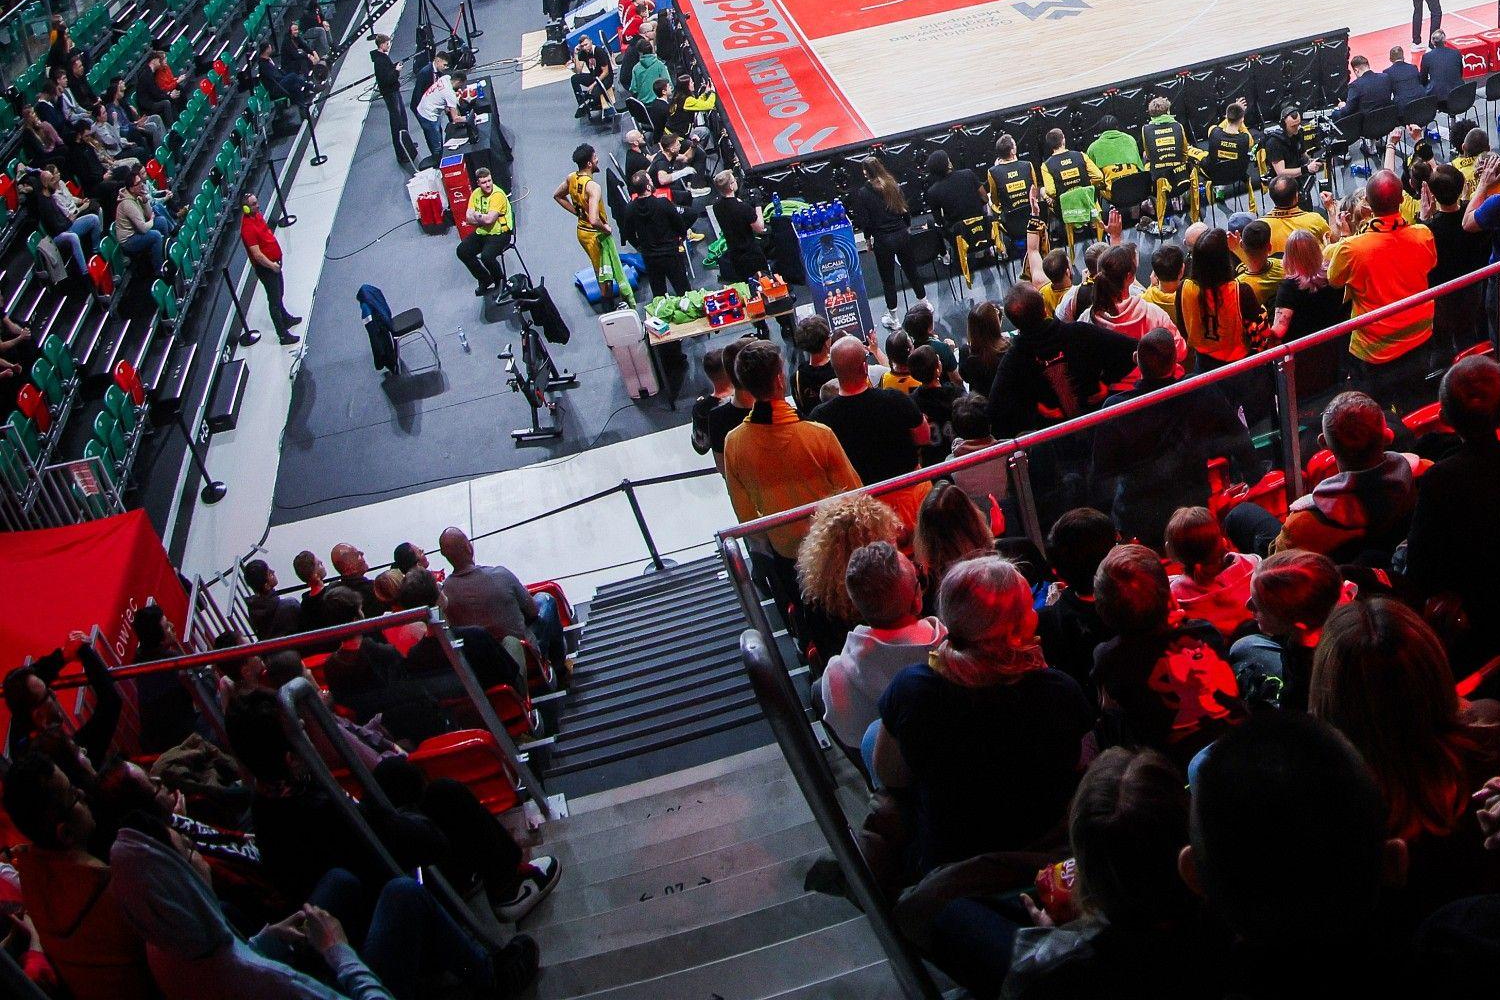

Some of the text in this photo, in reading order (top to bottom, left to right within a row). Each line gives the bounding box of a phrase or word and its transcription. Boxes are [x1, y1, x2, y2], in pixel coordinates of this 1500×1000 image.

[744, 57, 810, 119] ORLEN
[821, 260, 845, 270] ALCALIA
[833, 316, 857, 327] WODA
[115, 597, 139, 657] owiec
